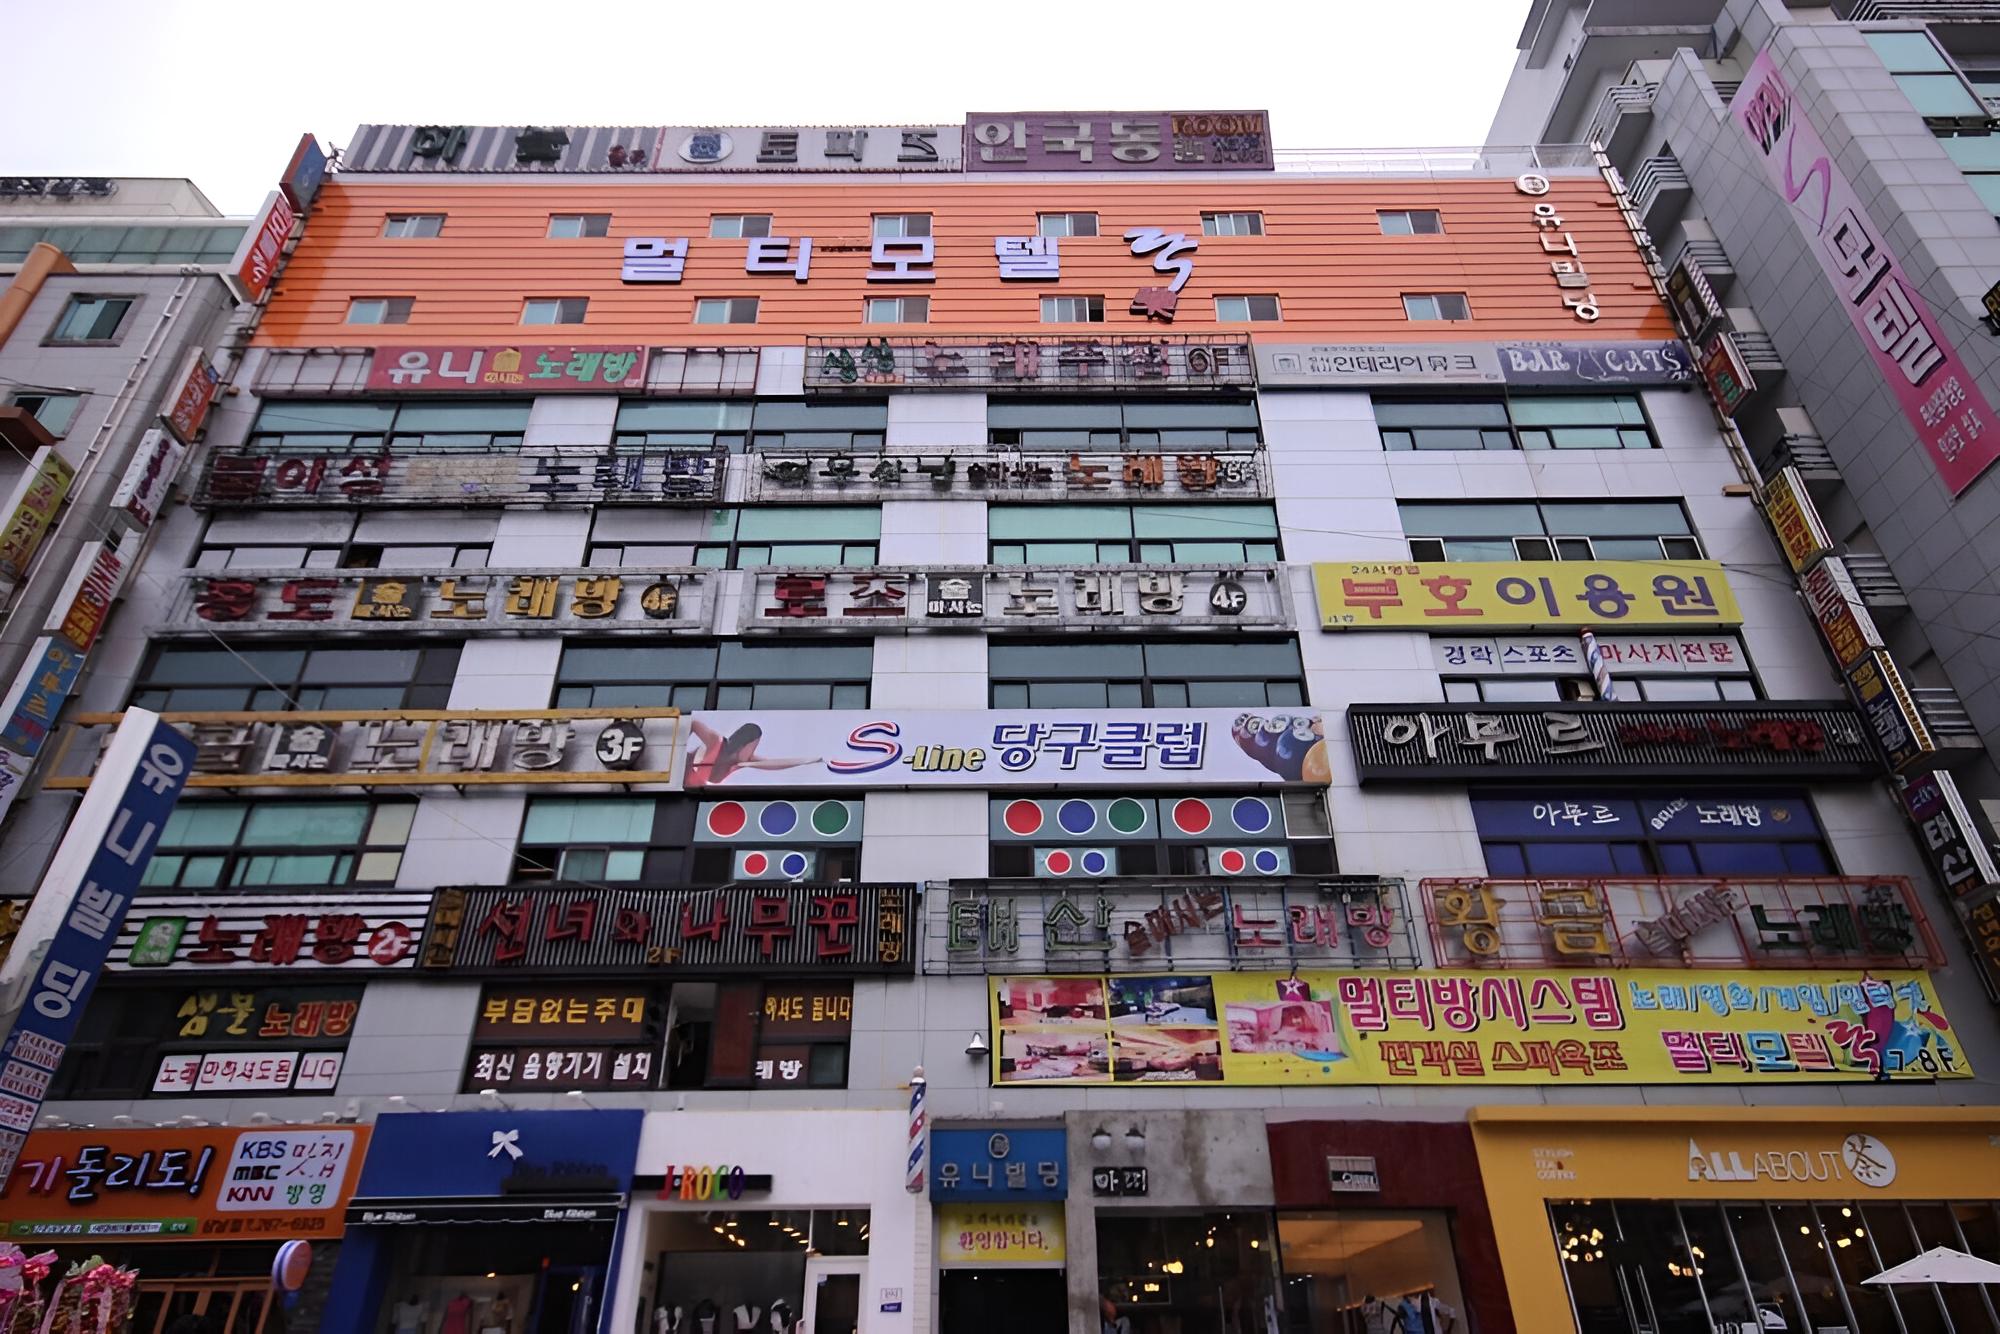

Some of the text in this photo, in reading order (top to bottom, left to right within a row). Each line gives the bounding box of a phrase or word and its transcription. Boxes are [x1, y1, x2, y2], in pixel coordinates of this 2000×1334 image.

[974, 119, 1161, 164] 안국동
[621, 236, 1061, 283] 멀티모텔
[1824, 206, 1948, 388] 모텔
[388, 351, 639, 385] 유니 노래방
[1508, 349, 1682, 373] BAR CATS
[430, 576, 622, 619] 노래방
[1003, 571, 1186, 616] 노래방
[1211, 585, 1247, 609] 4F
[1503, 644, 1578, 664] 스포츠
[350, 720, 576, 770] 노래방
[601, 734, 644, 762] 3F
[991, 721, 1207, 771] 당구클럽
[1384, 711, 1607, 760] 아무르
[1696, 804, 1762, 827] 노래방
[33, 742, 185, 1020] 유니빌딩
[187, 913, 367, 966] 노래방
[946, 895, 1117, 953] 태산
[1233, 901, 1395, 950] 노래방
[647, 947, 684, 964] 2F
[258, 1001, 357, 1038] 노래방
[1337, 976, 1626, 1032] 멀티방시스템
[473, 1052, 516, 1082] 최신
[521, 1051, 604, 1082] 음향기기
[239, 1140, 287, 1160] KBS
[226, 1183, 327, 1205] KNN 방영
[938, 1161, 1060, 1190] 유니빌딩
